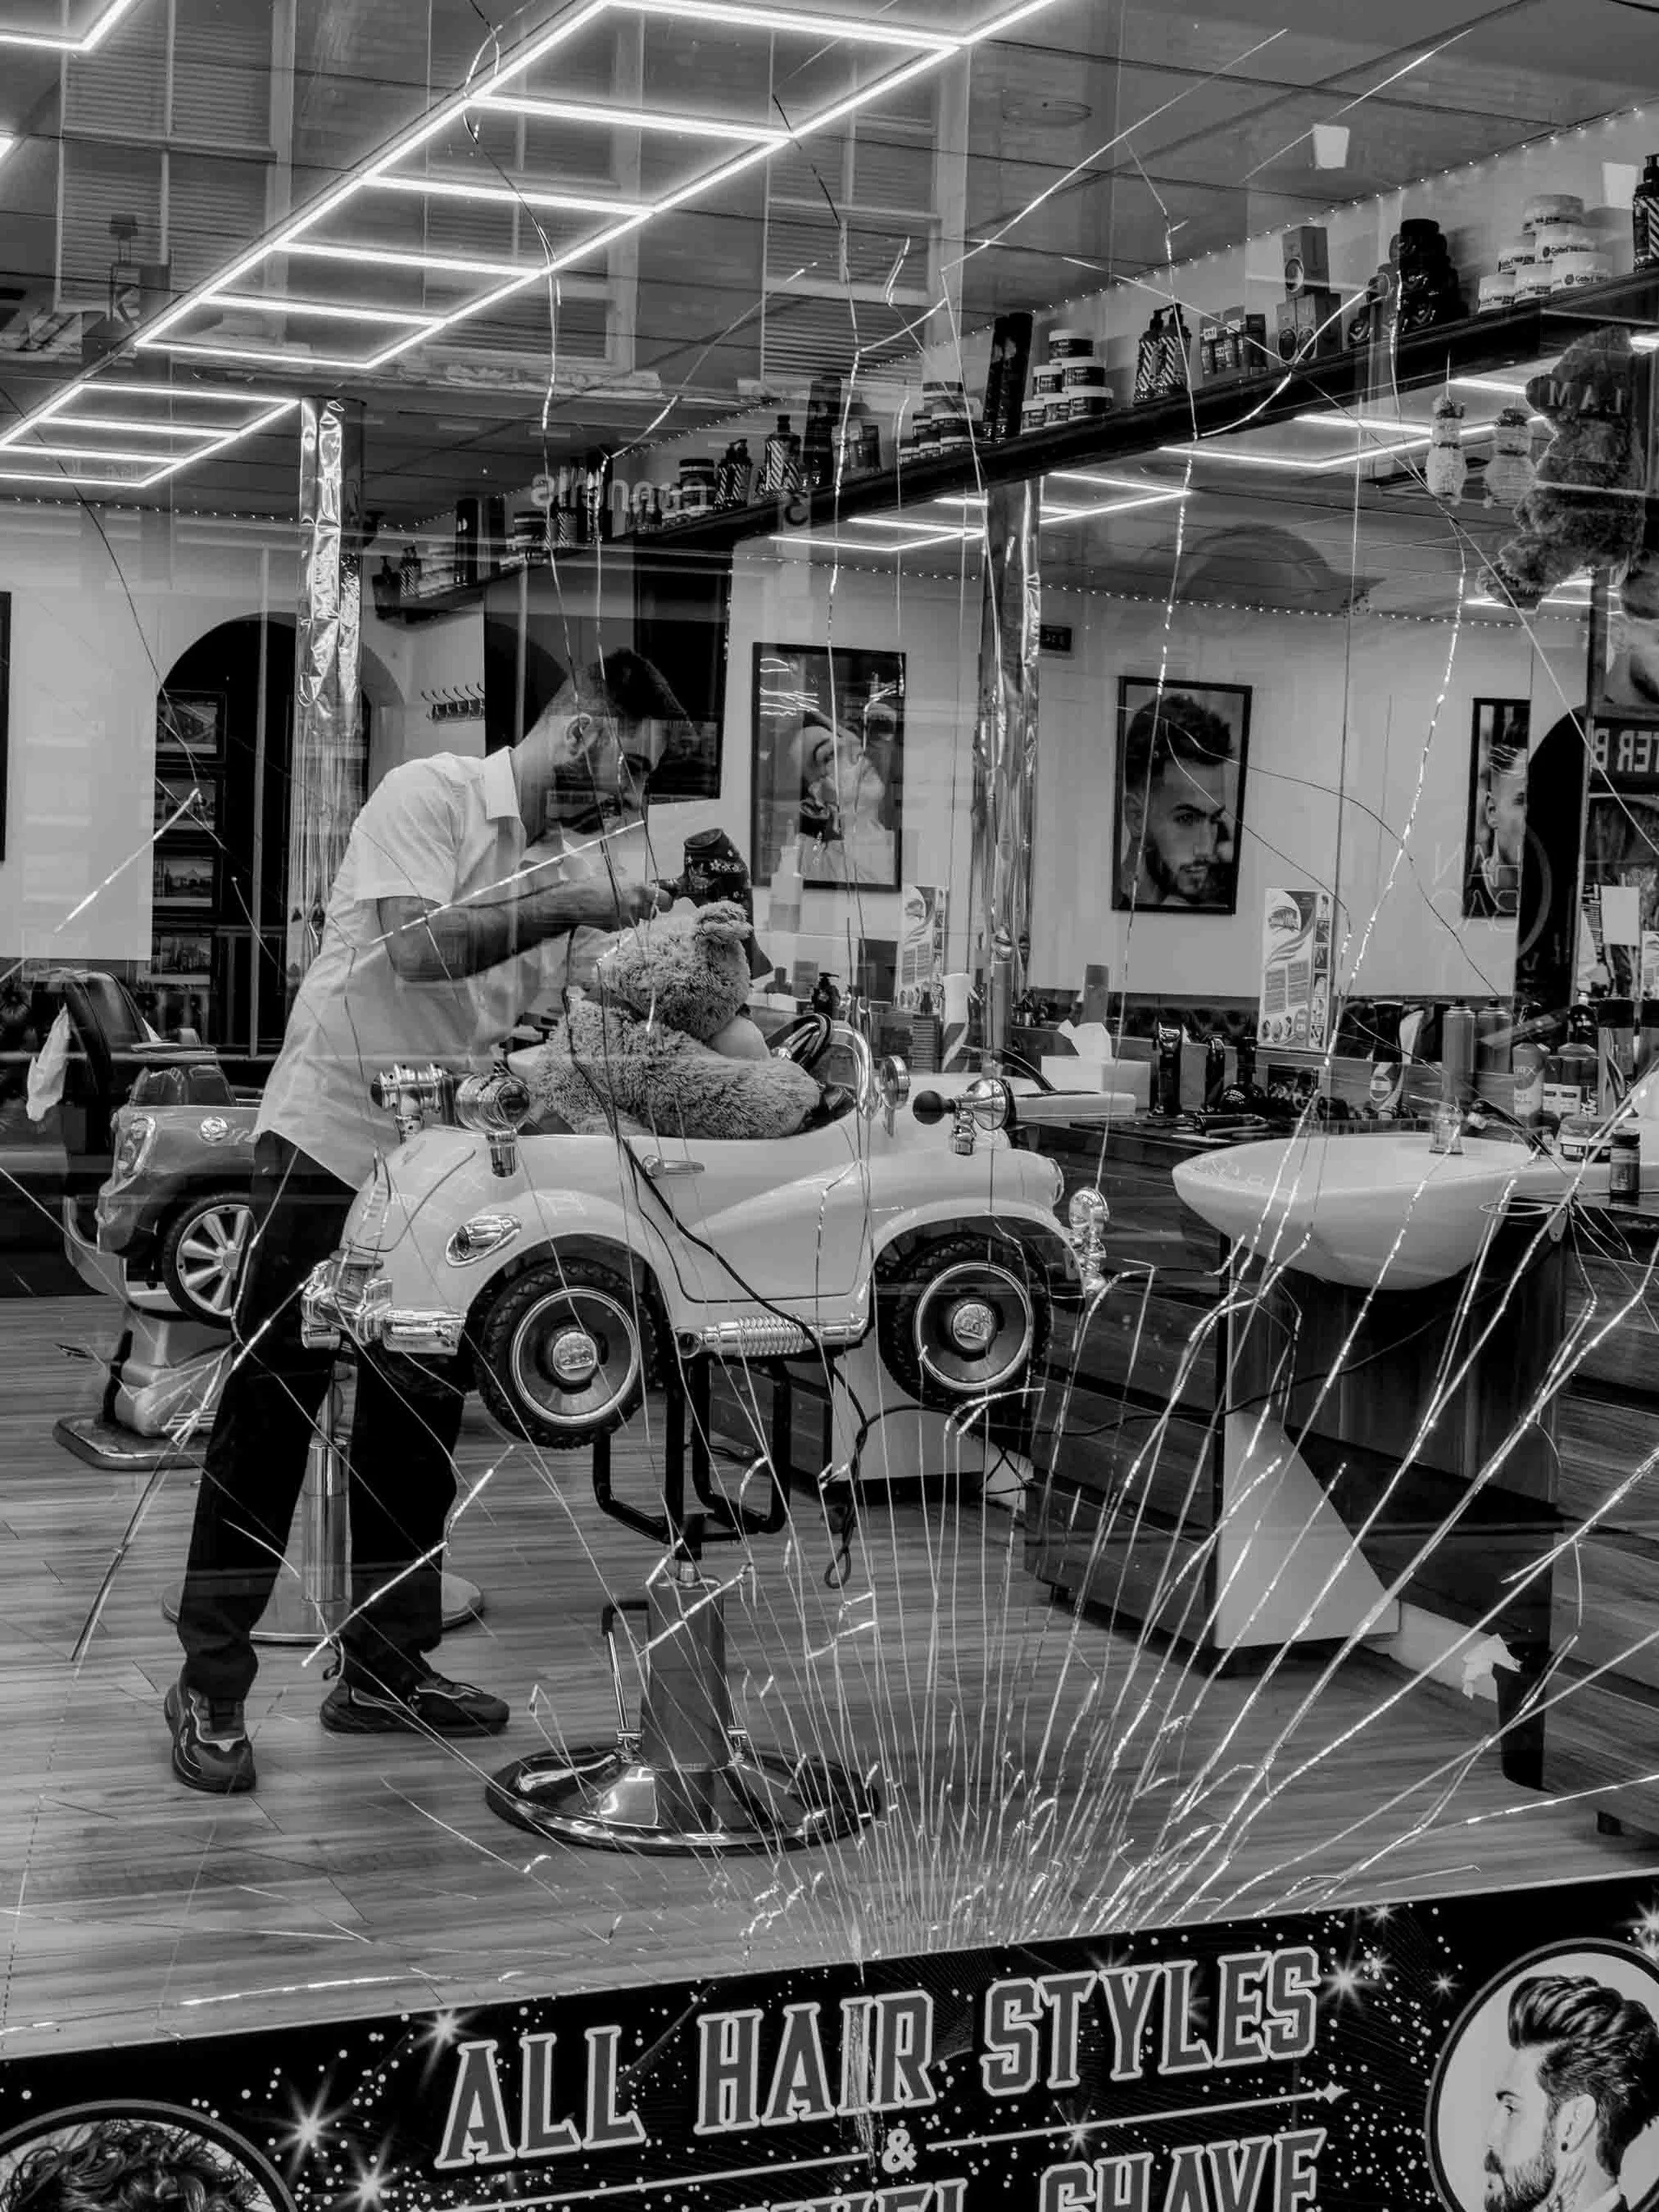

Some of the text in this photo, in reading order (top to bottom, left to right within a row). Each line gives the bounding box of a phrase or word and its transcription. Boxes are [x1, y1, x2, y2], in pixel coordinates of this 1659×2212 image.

[436, 1947, 1319, 2168] ALL HAIR STYLES
[882, 2128, 917, 2174] &
